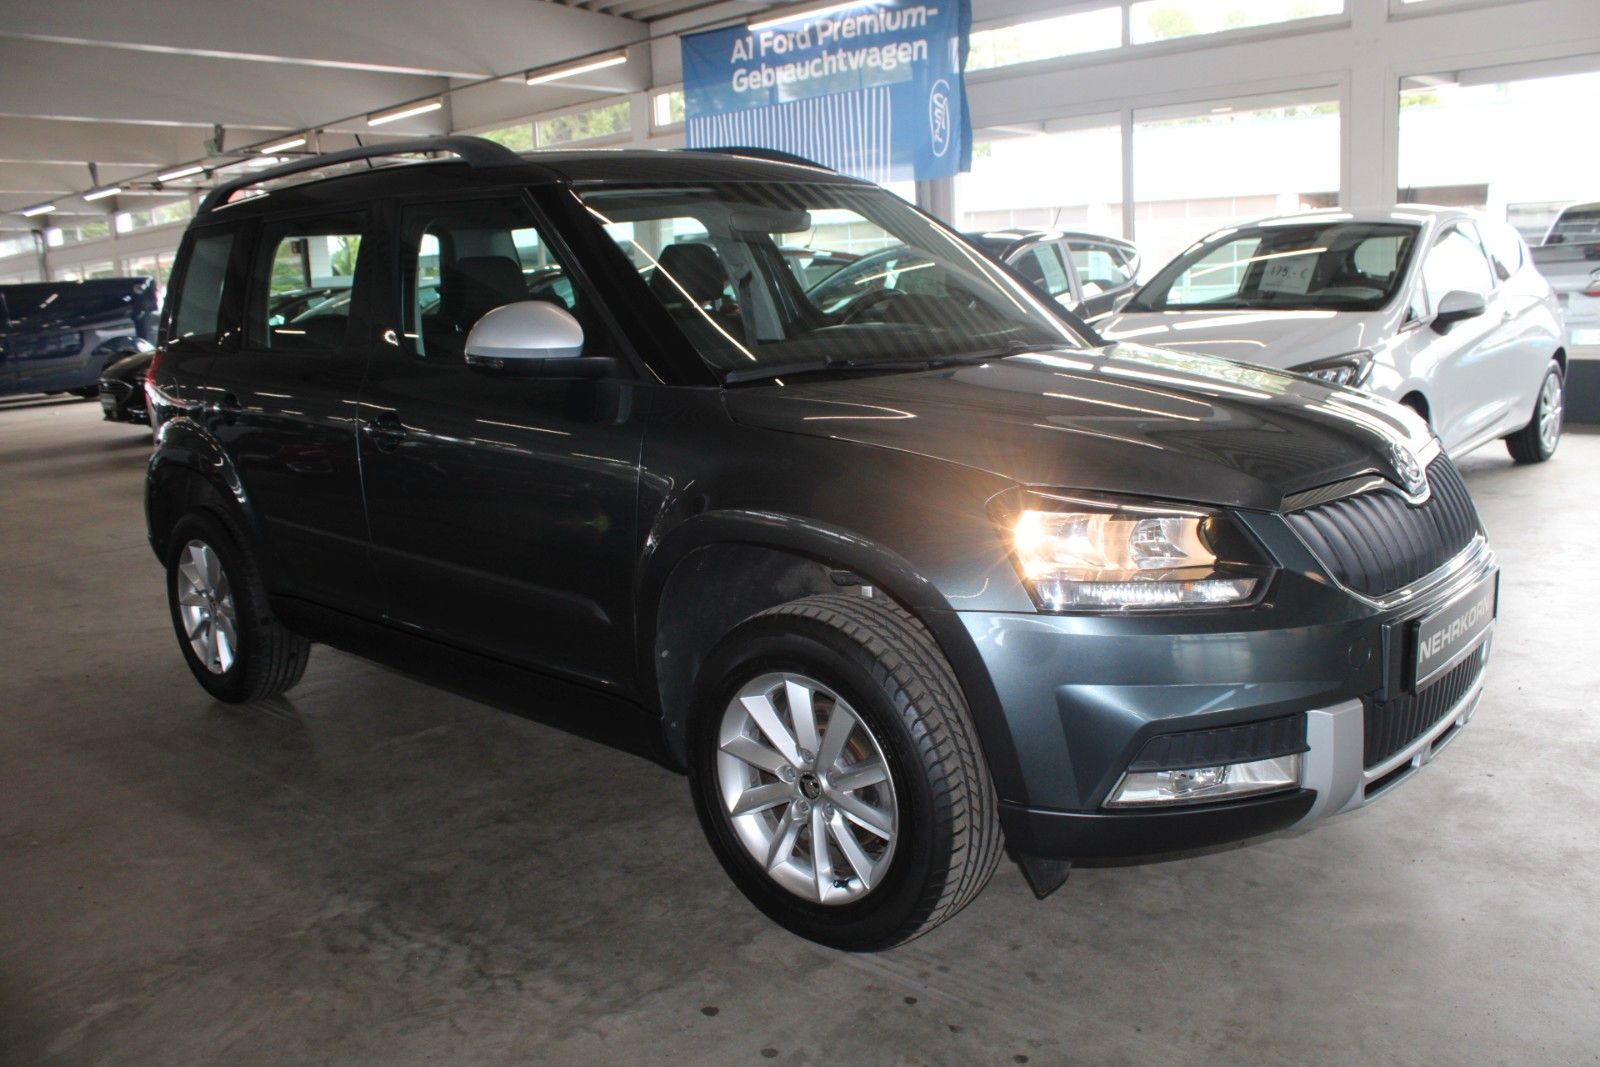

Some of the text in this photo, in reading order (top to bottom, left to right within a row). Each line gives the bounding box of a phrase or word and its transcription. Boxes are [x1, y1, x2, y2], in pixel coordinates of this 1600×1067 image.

[731, 5, 939, 63] A1 Ford Premium-
[732, 38, 928, 93] Gebrauchtwagen
[1418, 597, 1490, 663] NEHRKORN
